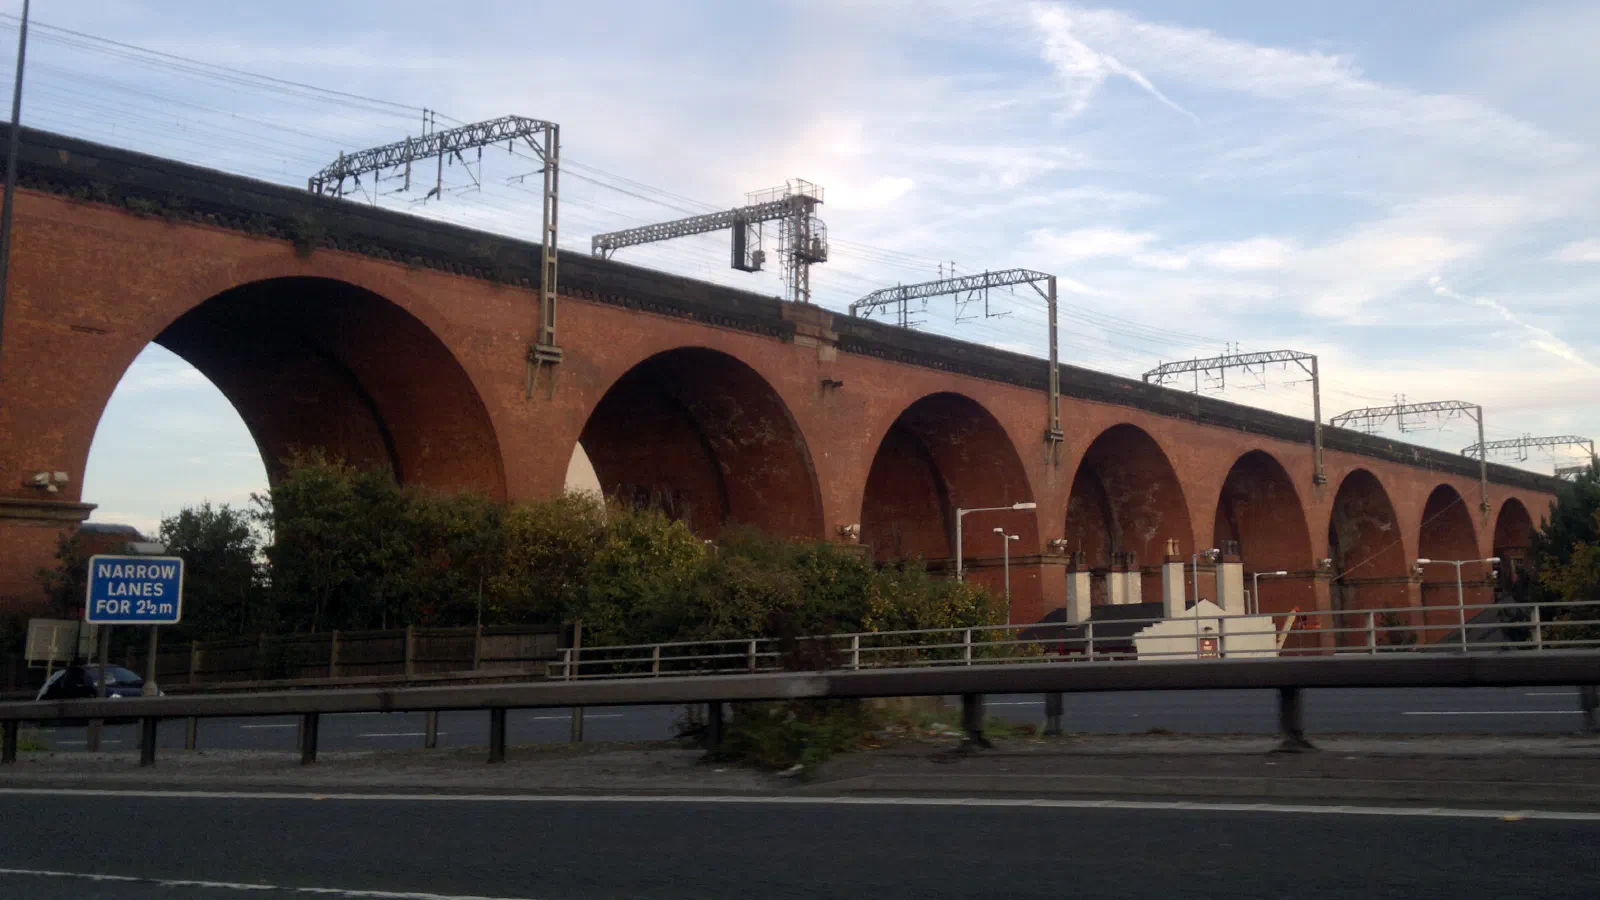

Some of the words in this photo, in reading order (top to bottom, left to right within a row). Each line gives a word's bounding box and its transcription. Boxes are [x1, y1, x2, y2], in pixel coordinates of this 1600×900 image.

[98, 564, 176, 579] NARROW
[107, 582, 164, 597] LANES
[95, 600, 131, 614] FOR
